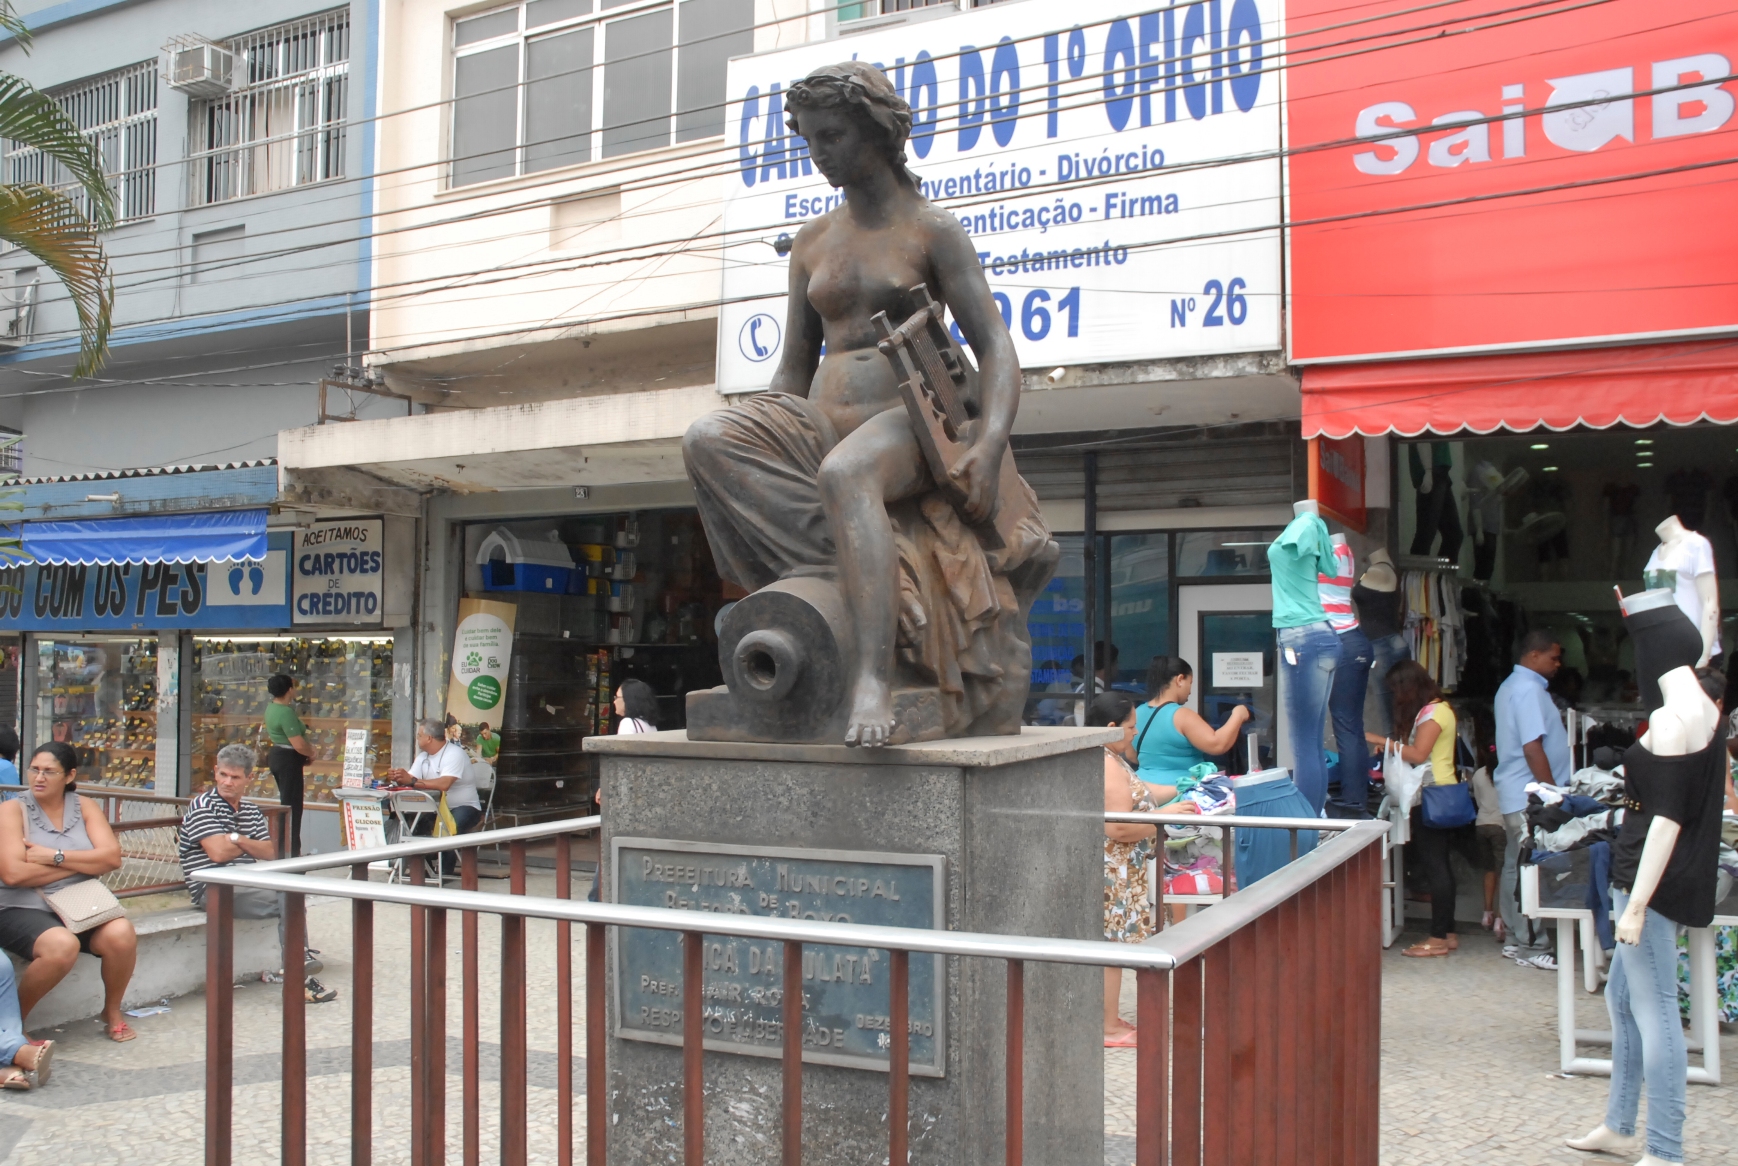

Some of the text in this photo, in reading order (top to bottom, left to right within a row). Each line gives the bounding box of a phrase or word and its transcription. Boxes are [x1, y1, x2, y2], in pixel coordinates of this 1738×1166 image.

[958, 35, 1020, 151] DO
[1043, 24, 1086, 138] 1º
[1103, 0, 1262, 132] OFÍCIO
[919, 162, 1032, 199] nventário
[1057, 144, 1165, 181] Divórcio
[1104, 192, 1180, 221] Firma
[977, 239, 1129, 277] Testamento
[1202, 277, 1248, 327] 26
[302, 527, 369, 547] ACEITAMOS
[298, 547, 382, 576] CARTÕES
[34, 559, 88, 619] COM
[94, 559, 131, 618] OS
[328, 579, 341, 589] DE
[296, 589, 378, 616] CRÉDITO
[352, 804, 381, 812] PRESSÃO
[355, 818, 382, 826] GLICOSE
[776, 863, 900, 902] MUNICIPAL
